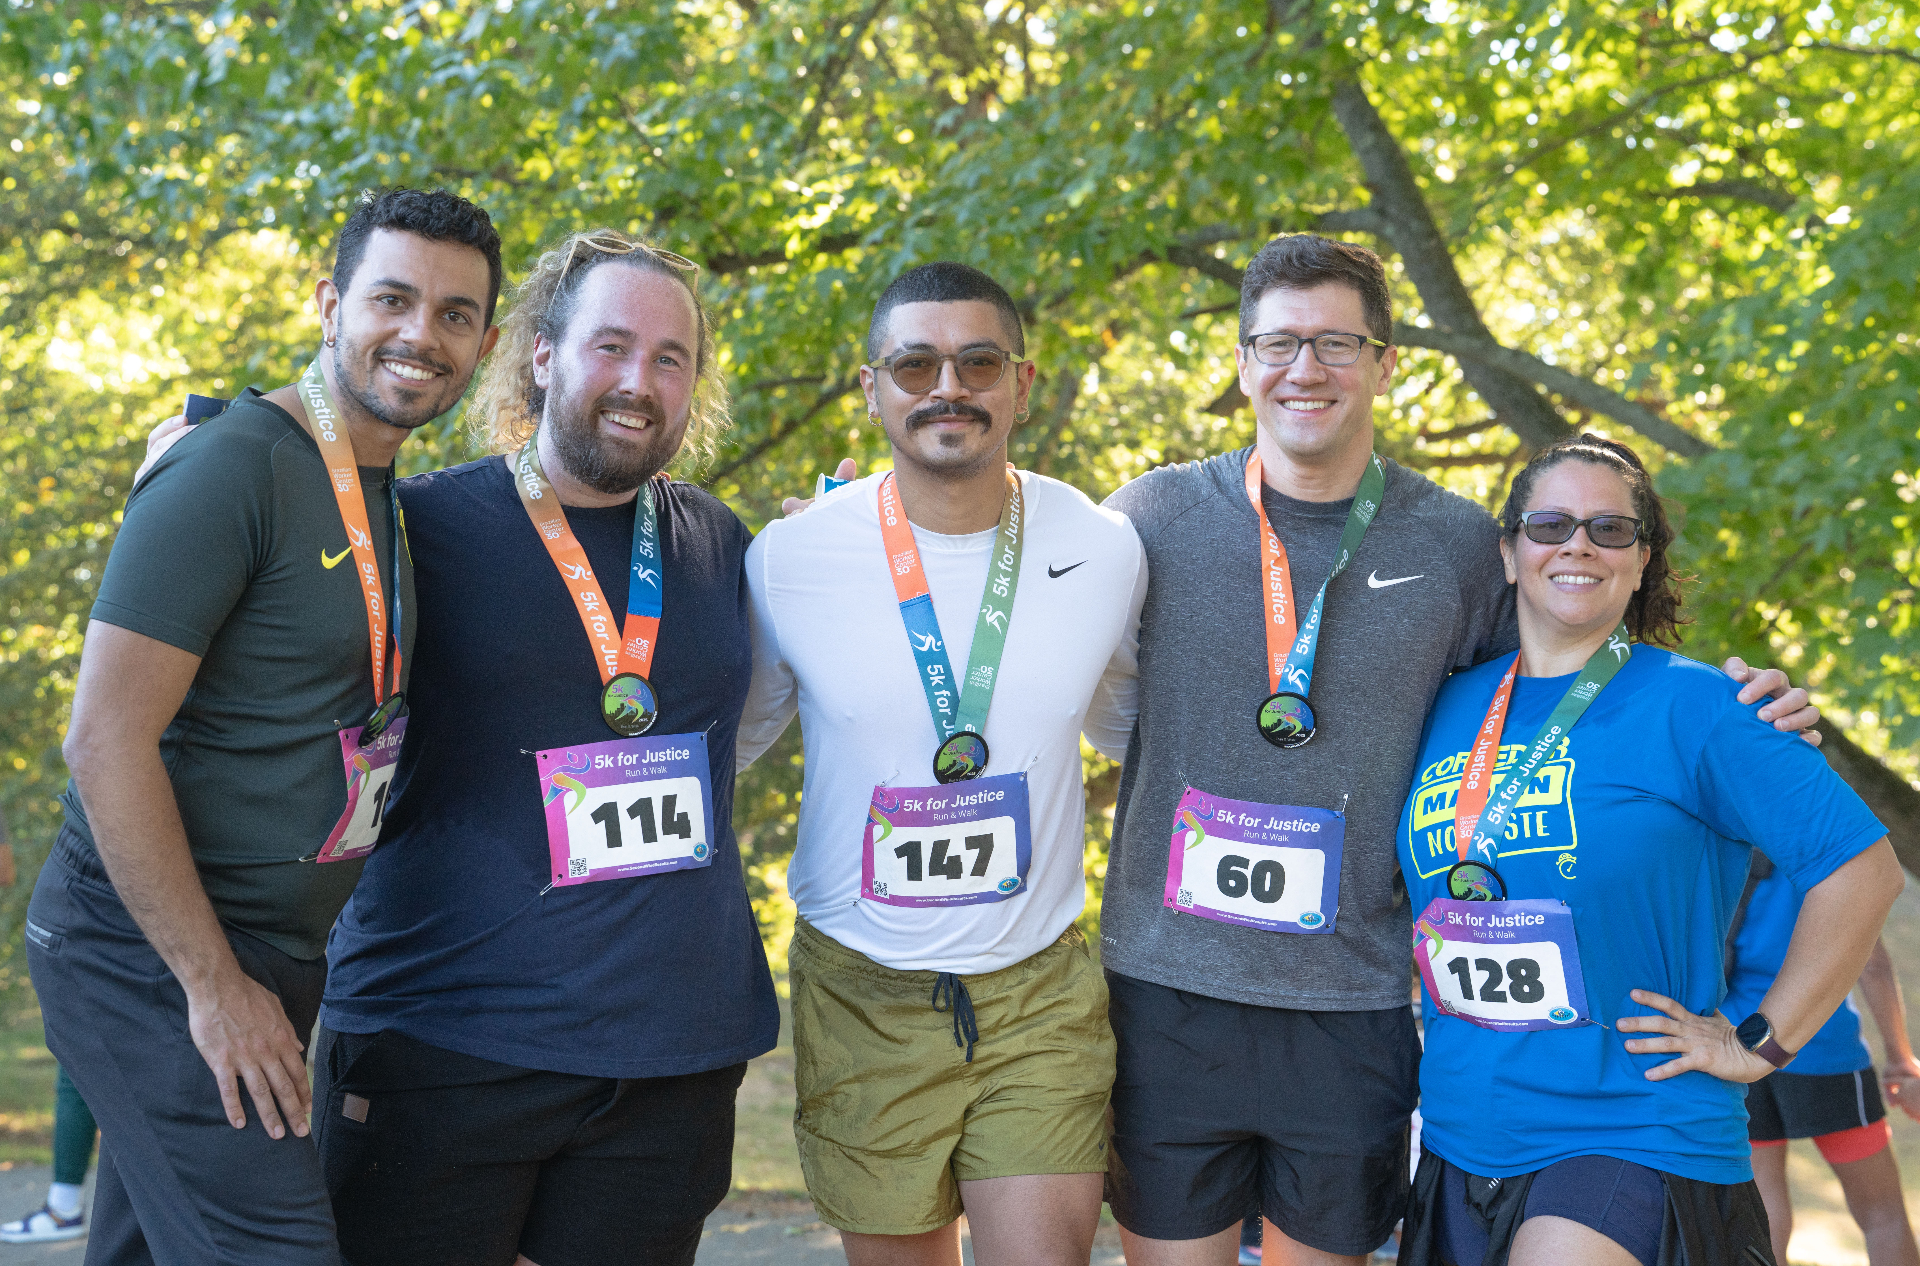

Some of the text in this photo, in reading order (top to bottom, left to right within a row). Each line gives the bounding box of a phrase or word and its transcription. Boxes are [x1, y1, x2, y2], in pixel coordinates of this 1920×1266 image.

[304, 380, 337, 442] Justice
[336, 484, 349, 492] 30
[1366, 500, 1376, 512] 30
[545, 532, 560, 540] 30
[640, 513, 653, 539] for
[639, 538, 654, 559] 5k
[993, 483, 1021, 598] 5k for Justice
[896, 566, 910, 576] 30
[1270, 560, 1288, 625] Justice
[580, 592, 600, 612] 5k
[590, 615, 610, 640] for
[362, 562, 383, 698] 5k for Justice
[1296, 633, 1312, 656] 5k
[1305, 606, 1319, 630] for
[635, 637, 650, 648] 30
[927, 665, 945, 687] 5k
[980, 665, 994, 675] 30
[612, 684, 624, 694] 5k
[1586, 681, 1600, 693] 30
[934, 690, 951, 715] for
[1270, 701, 1282, 711] 5k
[376, 736, 387, 750] 5k
[387, 733, 399, 747] for
[947, 742, 959, 752] 5k
[1466, 694, 1505, 790] 5k for Justice
[594, 747, 690, 769] 5k for Justice
[625, 765, 668, 778] Run & Walk
[1487, 726, 1561, 824] 5k for Justice
[371, 781, 390, 829] 1
[903, 790, 1005, 812] 5k for Justice
[590, 794, 692, 848] 114
[933, 812, 949, 821] Run
[958, 809, 978, 817] Walk
[1216, 810, 1321, 833] 5k for Justice
[1243, 829, 1289, 842] Run & Walk
[1427, 825, 1457, 857] NO
[1460, 830, 1472, 838] 30
[894, 833, 994, 881] 147
[1217, 854, 1286, 903] 60
[1456, 870, 1469, 879] 5k
[1447, 911, 1545, 927] 5k for Justice
[1473, 929, 1515, 939] Run & Walk
[1447, 957, 1545, 1004] 128
